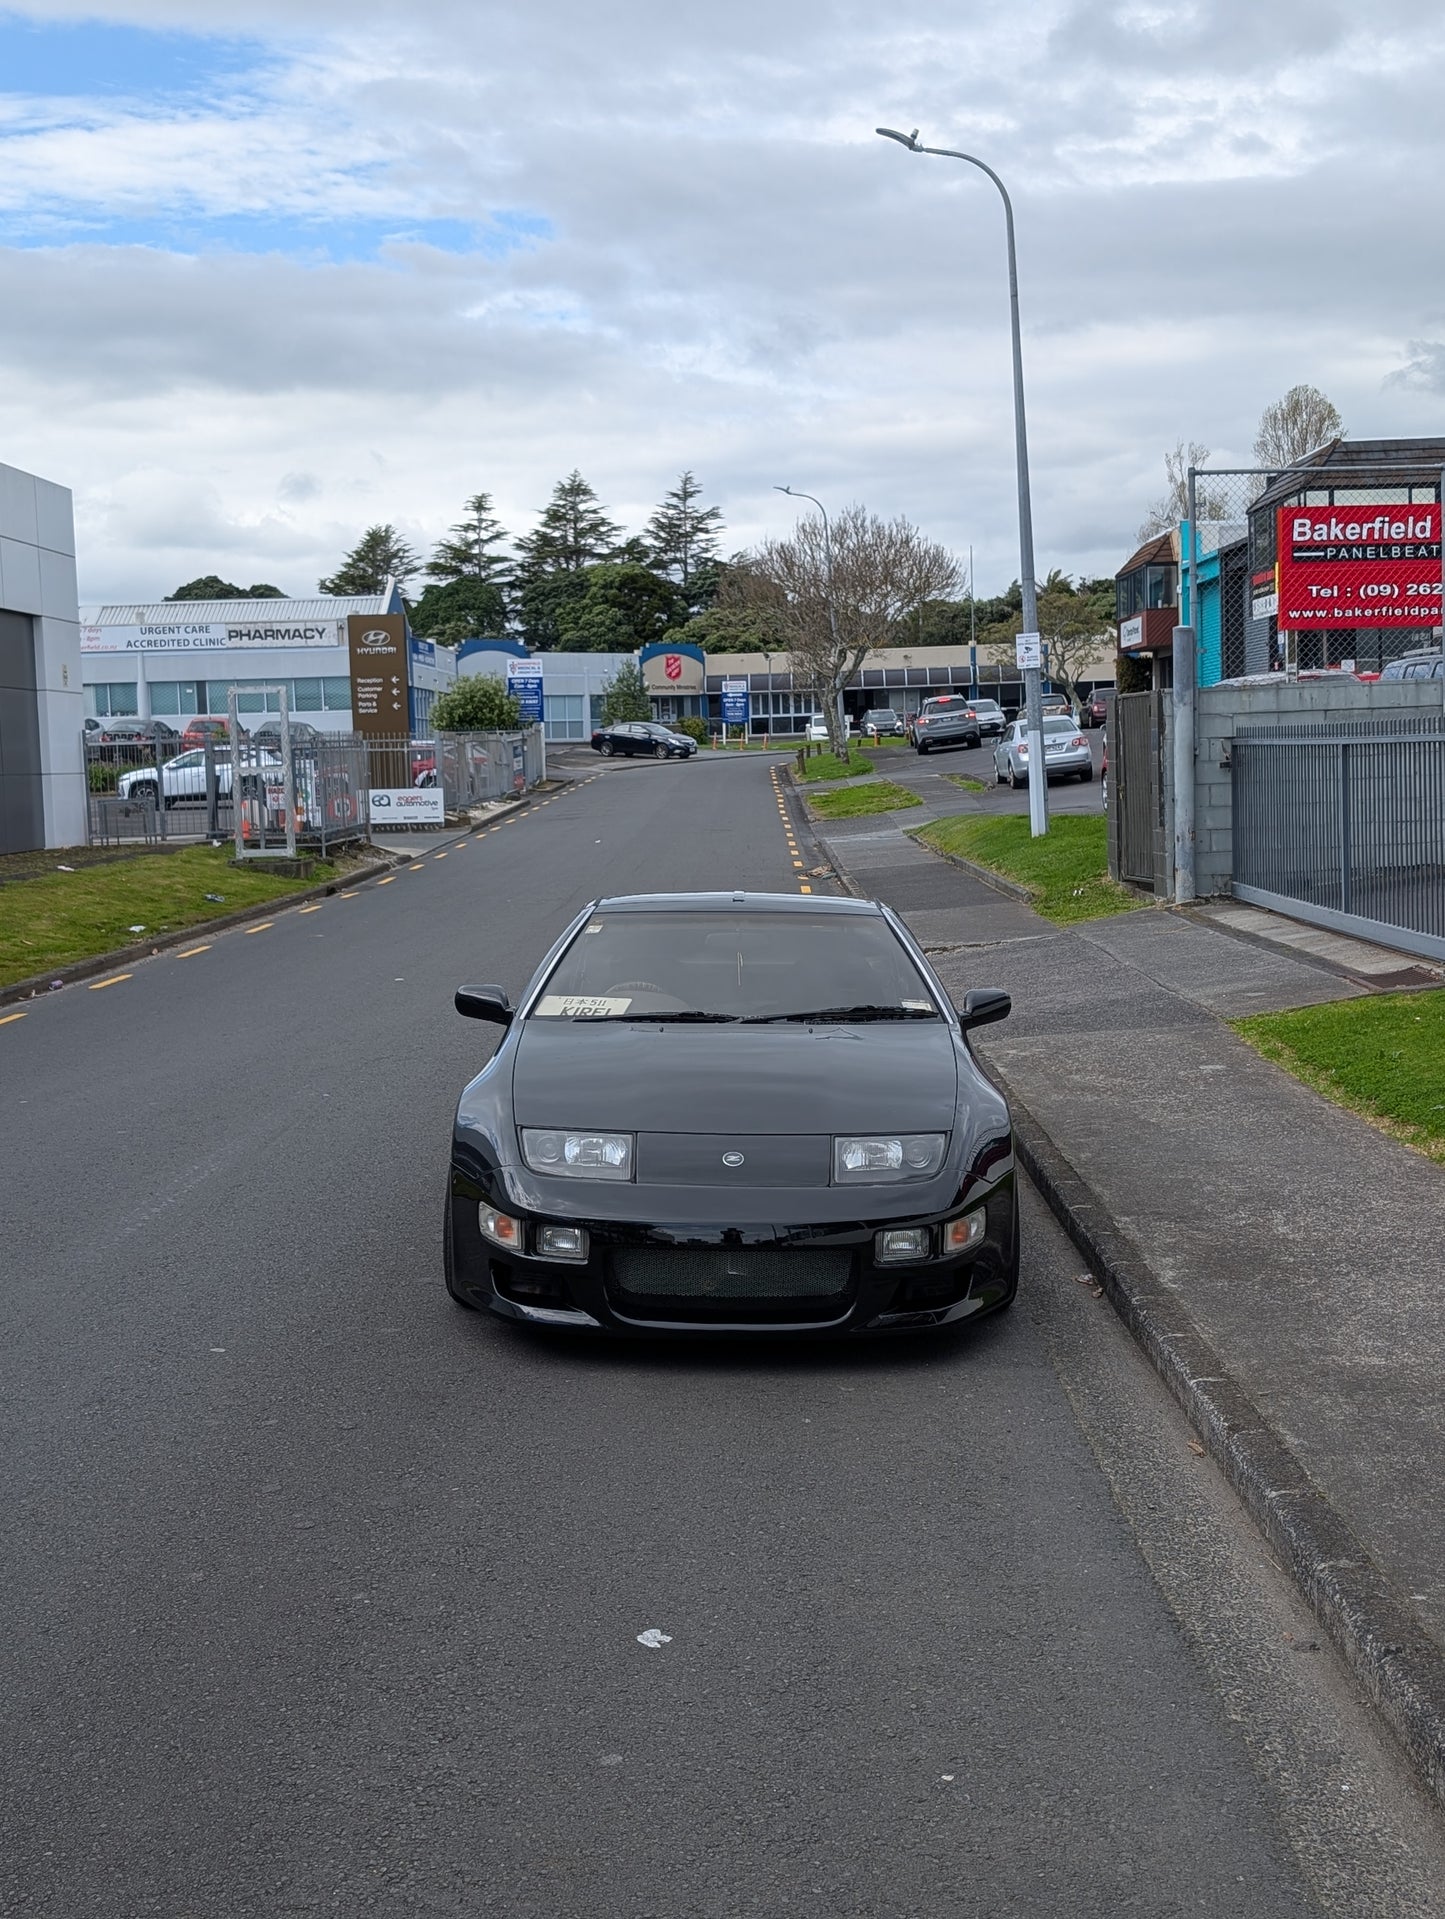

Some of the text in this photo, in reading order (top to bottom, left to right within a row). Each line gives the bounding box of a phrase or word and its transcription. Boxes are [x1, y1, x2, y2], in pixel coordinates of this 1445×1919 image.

[1292, 515, 1432, 542] Bakerfield
[1326, 545, 1440, 559] PANELBEAT
[1308, 585, 1338, 598] Tel
[1359, 584, 1399, 600] (09)
[1405, 583, 1444, 596] 262
[1288, 605, 1444, 619] www.bakerfieldpa
[140, 625, 211, 636] URGENT CARE
[228, 627, 327, 642] PHARMACY
[126, 637, 226, 650] ACCREDITED CLINIC
[356, 646, 397, 655] HYUNDAI
[358, 692, 378, 700] Parking
[395, 799, 439, 808] automotive
